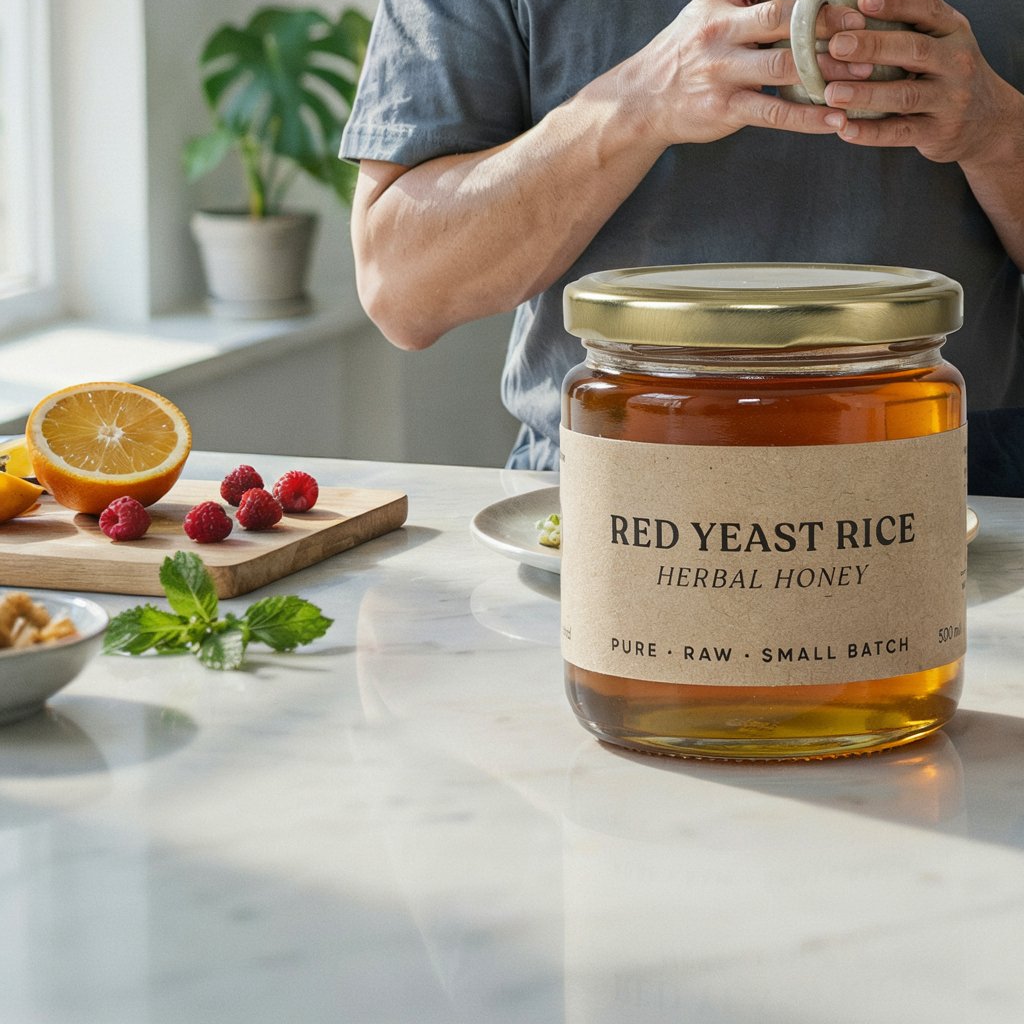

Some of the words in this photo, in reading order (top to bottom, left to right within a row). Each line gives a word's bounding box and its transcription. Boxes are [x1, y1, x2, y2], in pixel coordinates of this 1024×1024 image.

[610, 514, 679, 549] RED
[689, 520, 824, 553] YEAST
[835, 512, 916, 550] RICE
[656, 565, 763, 589] HERBAL
[774, 563, 870, 589] HONEY
[938, 625, 954, 644] 500
[611, 637, 657, 658] PURE
[684, 645, 733, 663] RAW
[761, 645, 837, 663] SMALL
[847, 636, 909, 659] BATCH
